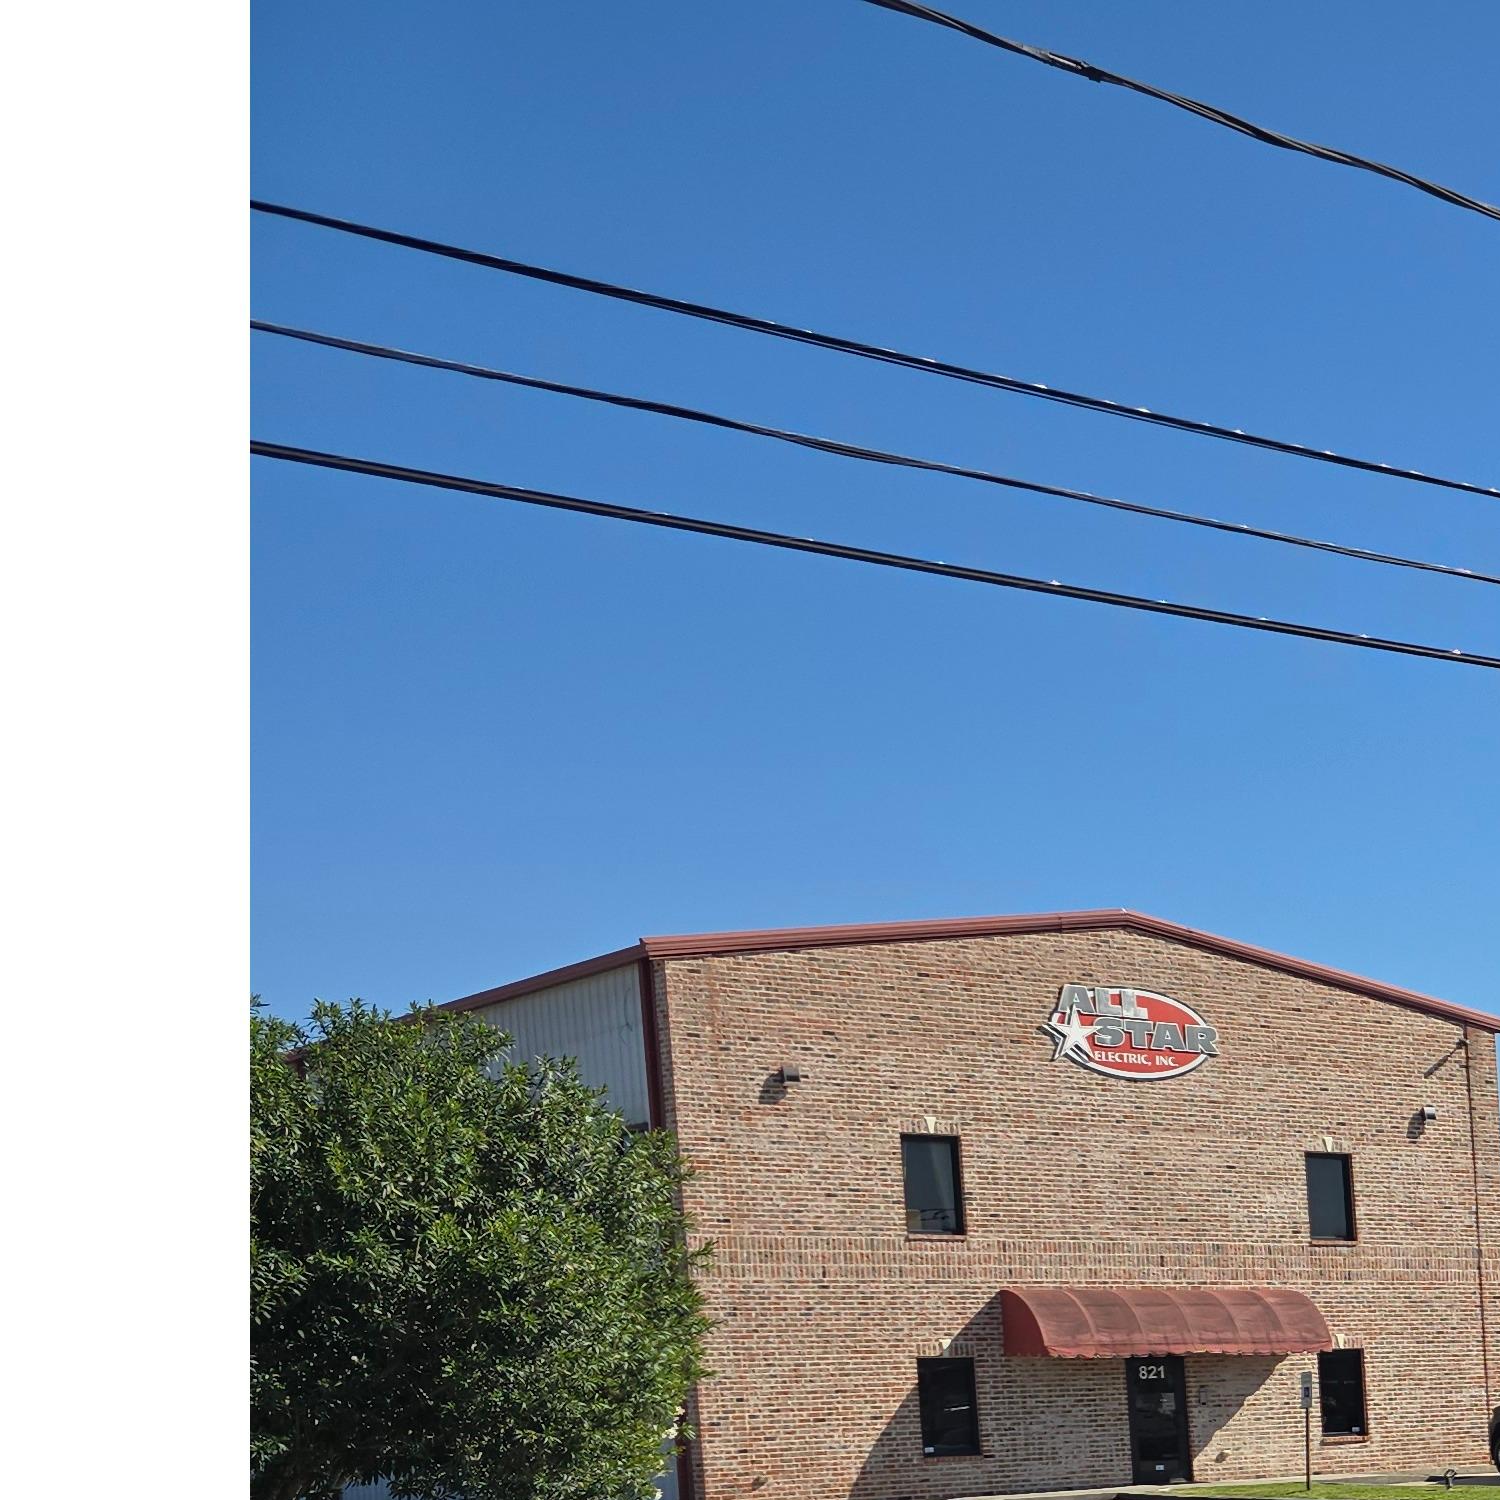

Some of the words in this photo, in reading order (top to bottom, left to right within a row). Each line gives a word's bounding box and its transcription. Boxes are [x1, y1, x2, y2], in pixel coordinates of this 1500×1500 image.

[1057, 984, 1149, 1019] ALL
[1094, 1017, 1220, 1055] STAR
[1155, 1055, 1179, 1067] INC.
[1139, 1365, 1165, 1379] 821
